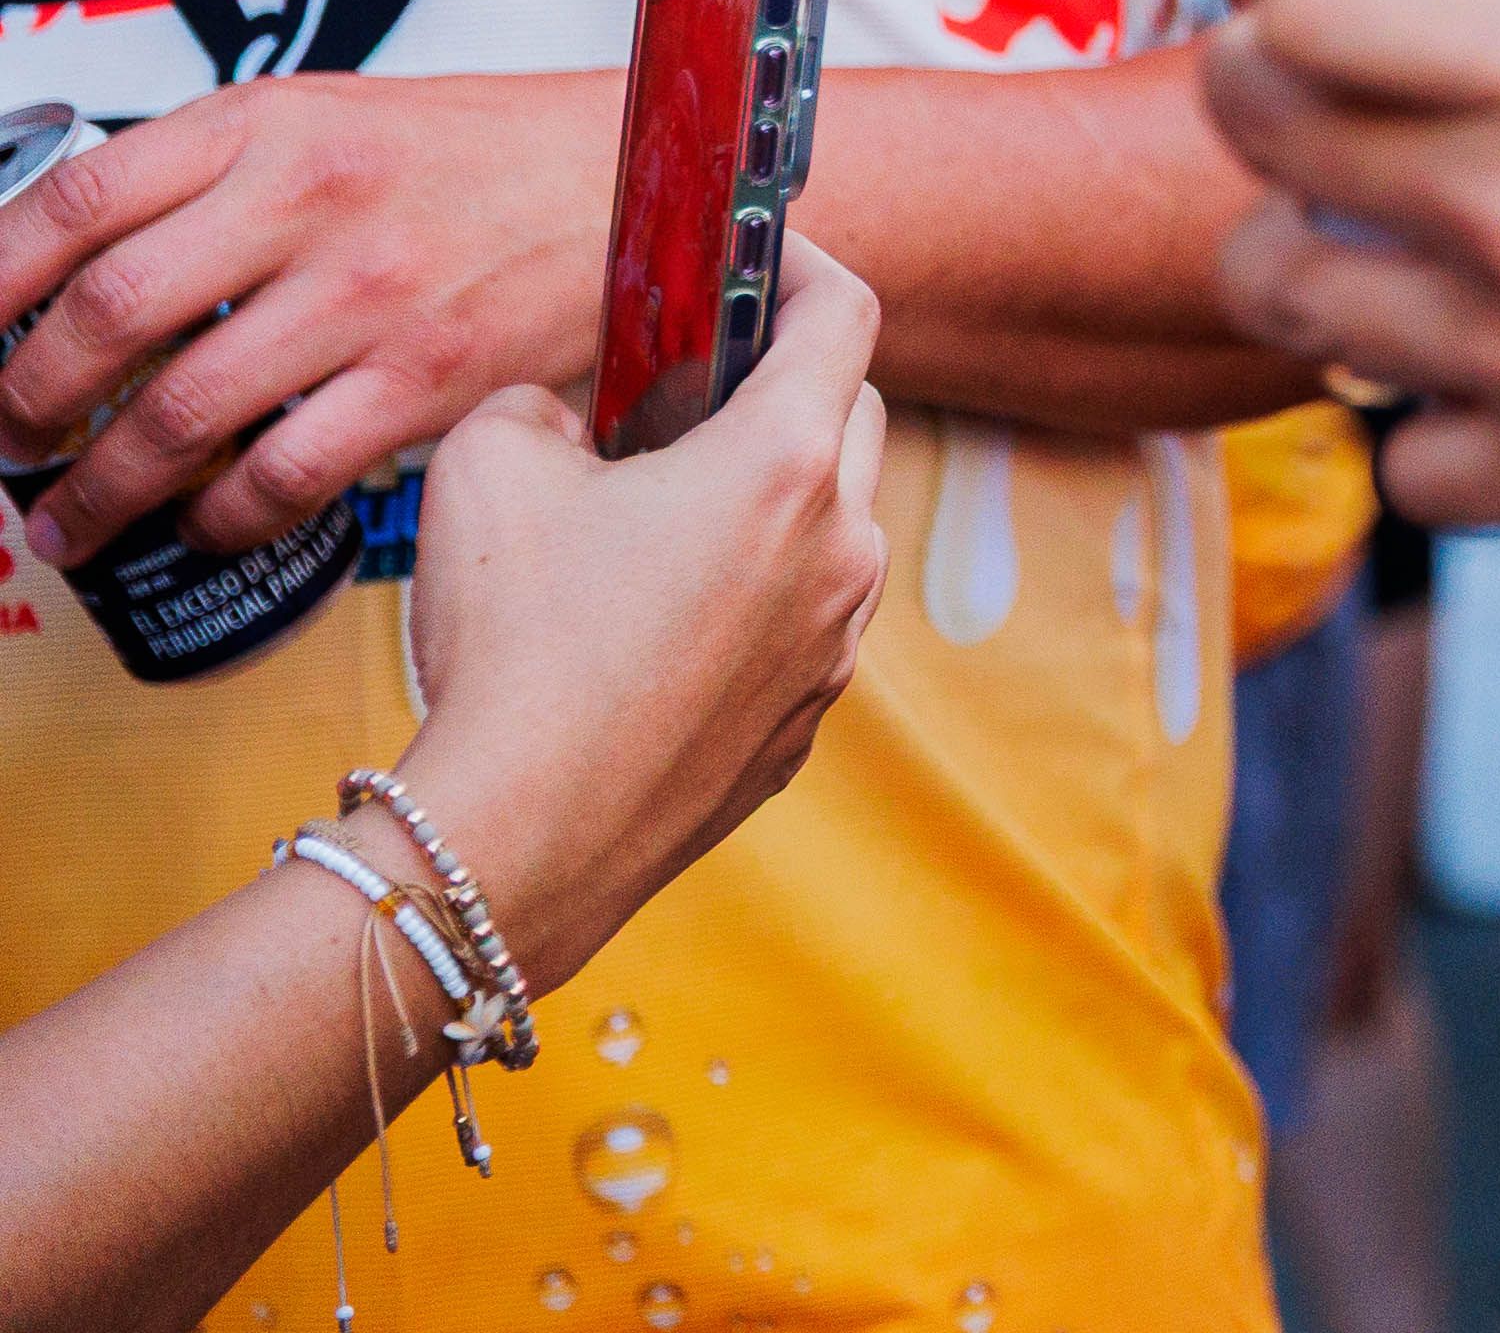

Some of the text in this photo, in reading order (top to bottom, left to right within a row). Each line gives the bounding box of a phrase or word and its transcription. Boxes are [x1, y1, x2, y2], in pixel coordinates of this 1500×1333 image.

[130, 608, 161, 637] EL
[155, 567, 245, 628] EXCESO
[239, 545, 276, 584] DE
[146, 586, 276, 661] PERJUDICIAL
[264, 547, 319, 602] PARA
